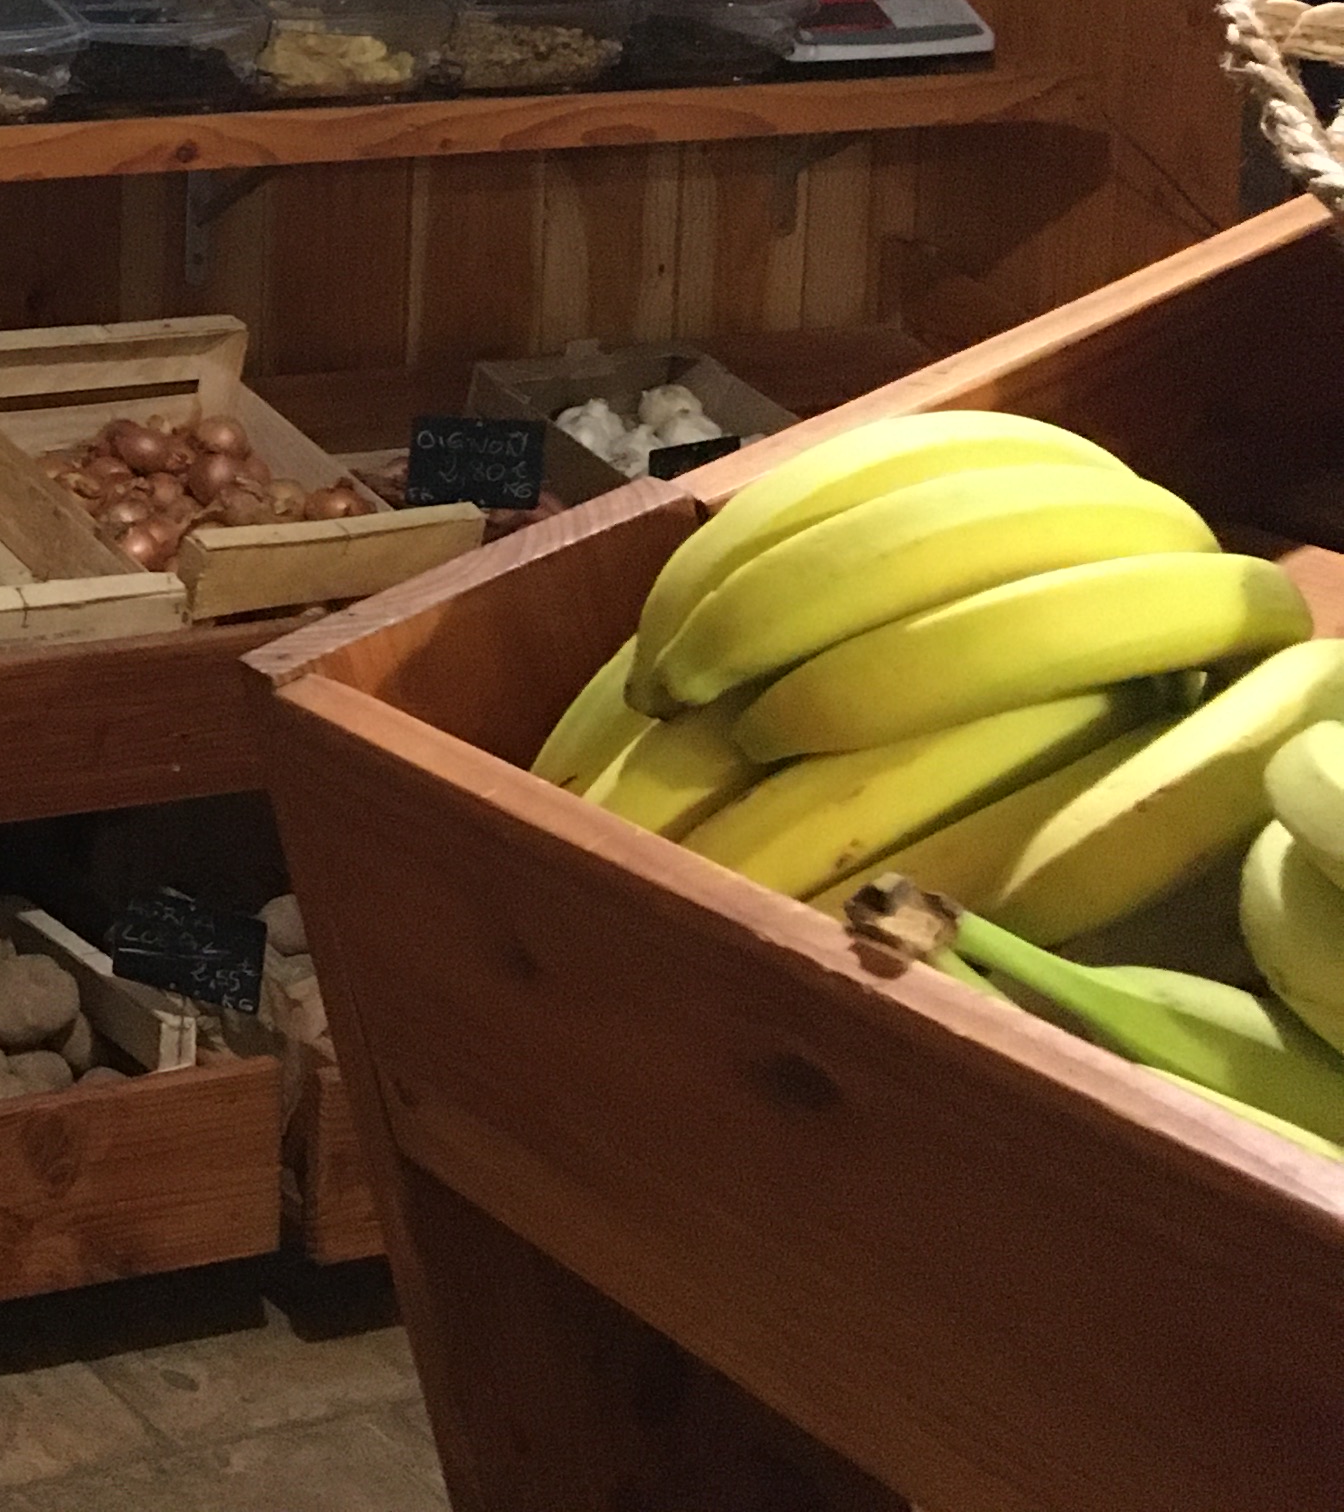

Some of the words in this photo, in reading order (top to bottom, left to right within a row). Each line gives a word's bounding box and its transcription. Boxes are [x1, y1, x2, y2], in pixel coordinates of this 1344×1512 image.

[417, 430, 528, 457] OIGNON
[503, 482, 533, 499] KG
[222, 994, 254, 1011] KG
